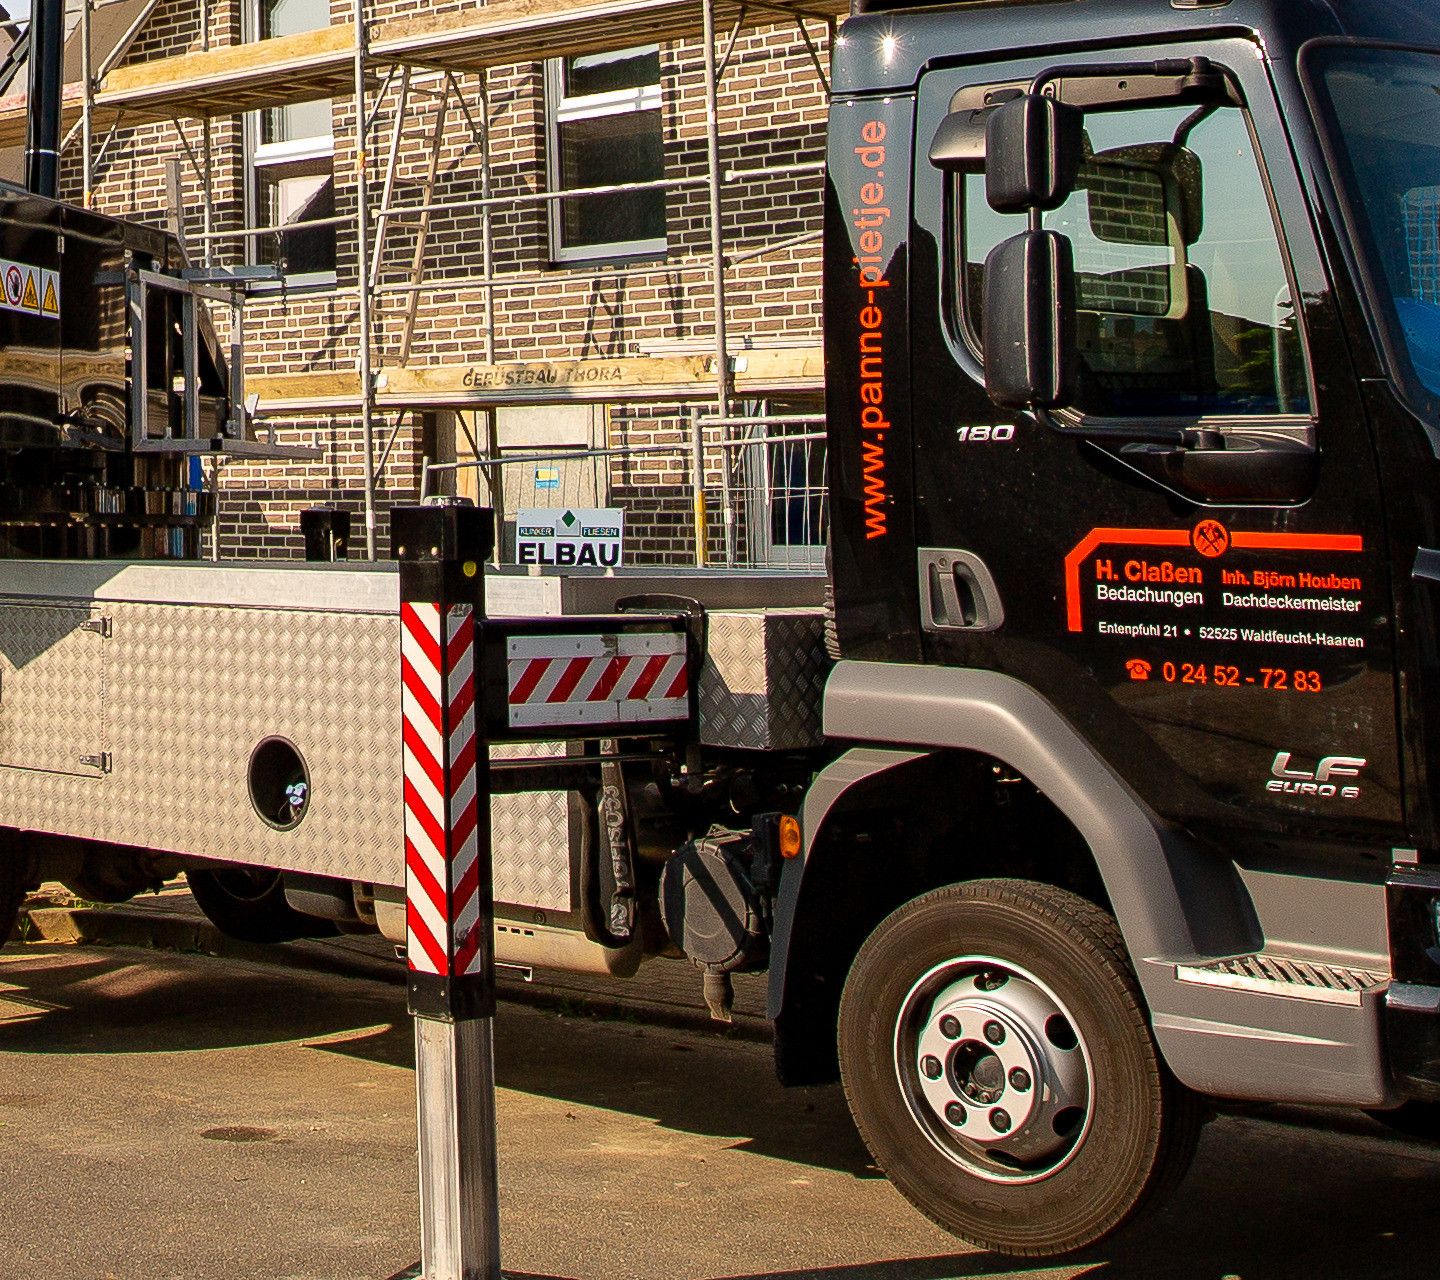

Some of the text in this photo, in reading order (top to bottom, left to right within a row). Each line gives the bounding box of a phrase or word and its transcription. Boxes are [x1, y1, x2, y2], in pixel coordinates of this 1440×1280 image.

[852, 120, 891, 540] www.panne-pietje.de
[956, 424, 1015, 441] 180
[519, 543, 620, 566] ELBAU
[1096, 560, 1203, 584] H. Claßen
[1222, 569, 1361, 590] Inh. Björn Houben
[1097, 584, 1203, 608] Bedachungen
[1222, 592, 1361, 612] Dachdeckermeister
[1098, 621, 1364, 648] Entenpfuhl 21 52525 Waldfeucht-Haaren
[1163, 661, 1176, 682] 0
[1181, 663, 1208, 685] 24
[1214, 665, 1240, 687] 52
[1260, 668, 1288, 690] 72
[1293, 670, 1321, 692] 83
[1271, 751, 1367, 781] LF
[1265, 780, 1360, 798] EURO 6
